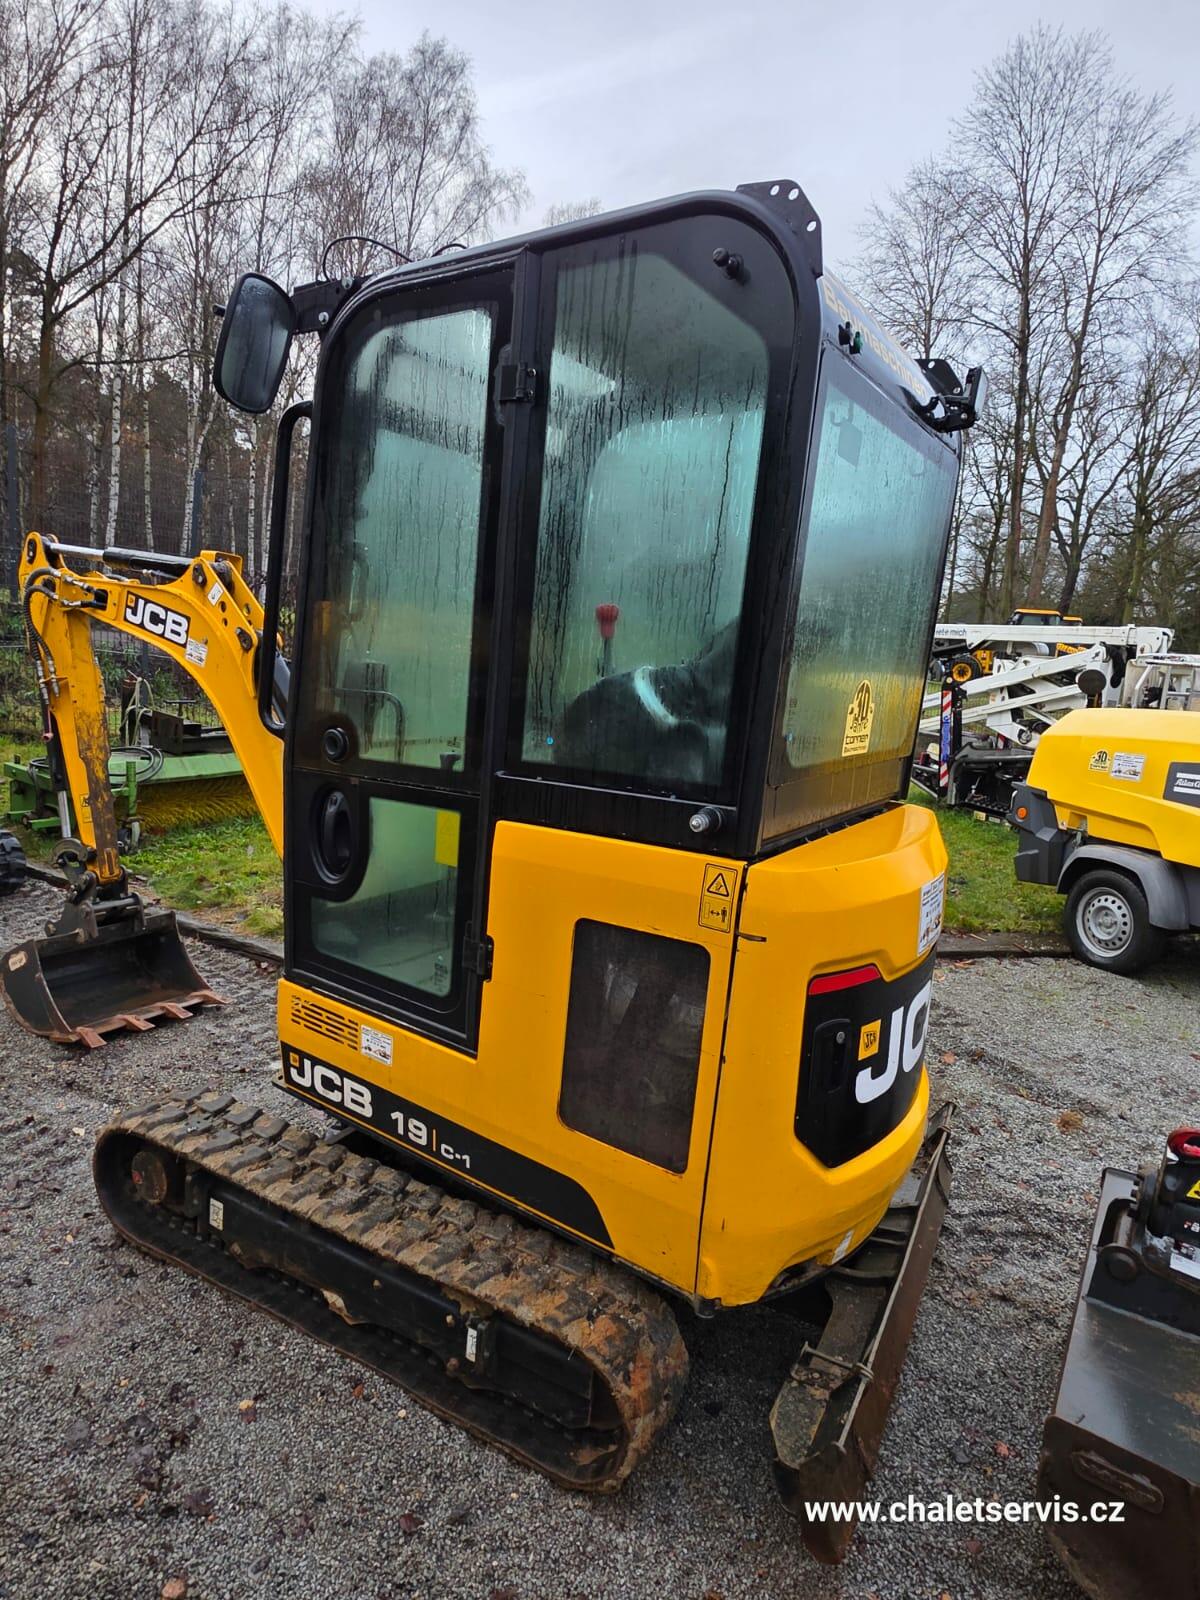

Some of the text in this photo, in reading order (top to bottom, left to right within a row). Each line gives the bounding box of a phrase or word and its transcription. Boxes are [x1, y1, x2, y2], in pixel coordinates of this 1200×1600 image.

[125, 598, 189, 645] JCB
[289, 1058, 373, 1118] JCB
[390, 1111, 471, 1169] 19 C-1
